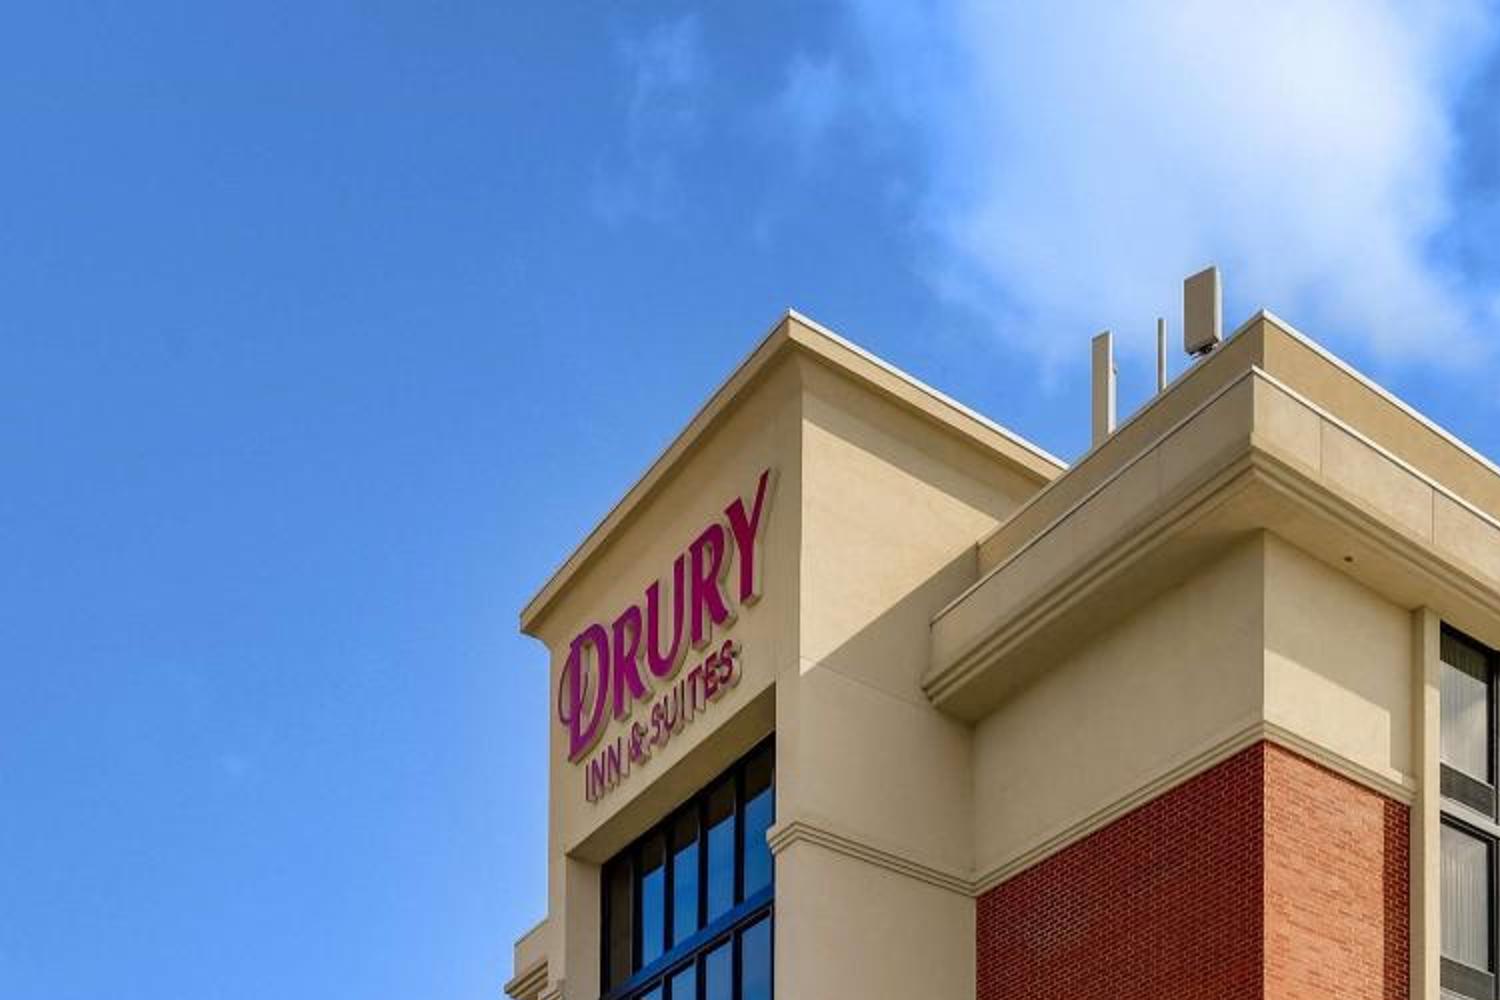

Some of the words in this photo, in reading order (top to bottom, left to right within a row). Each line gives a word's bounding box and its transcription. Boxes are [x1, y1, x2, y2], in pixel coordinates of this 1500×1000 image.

[558, 468, 770, 762] DRURY
[585, 736, 623, 801] INN
[630, 720, 649, 765] &
[651, 639, 738, 746] SUITES
